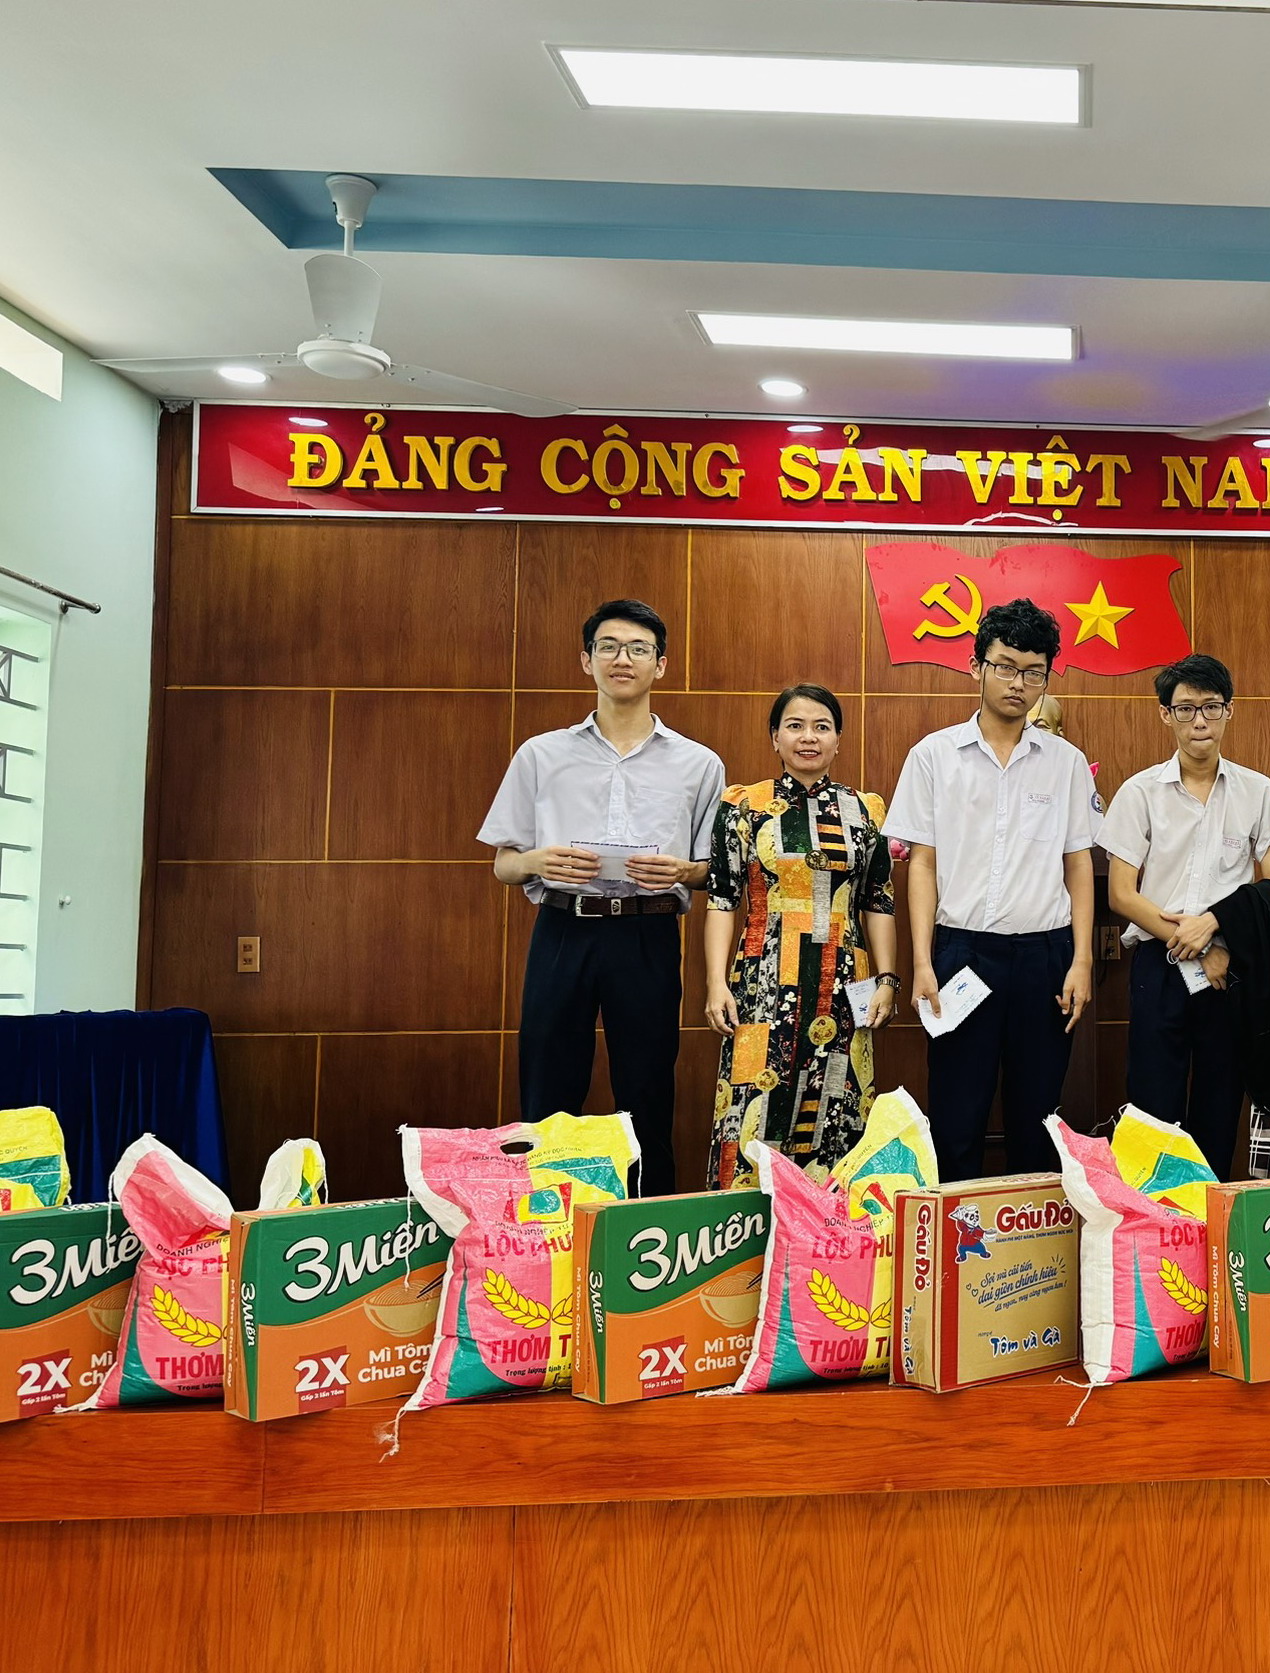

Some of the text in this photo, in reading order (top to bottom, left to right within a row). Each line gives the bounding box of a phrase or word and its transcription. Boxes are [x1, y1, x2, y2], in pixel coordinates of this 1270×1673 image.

[287, 412, 508, 493] ĐẢNG
[540, 424, 747, 511] CỘNG
[777, 424, 926, 504] SẢN
[956, 434, 1132, 521] VIỆT
[488, 1334, 552, 1364] THƠM
[704, 1337, 730, 1354] Mì
[809, 1336, 869, 1363] THƠM
[990, 1327, 1060, 1356] Tôm và Gà
[91, 1351, 113, 1369] Mì
[369, 1347, 391, 1365] Mì
[638, 1344, 688, 1381] 2X
[695, 1356, 738, 1373] Chua
[17, 1357, 72, 1396] 2X
[294, 1354, 350, 1393] 2X
[358, 1362, 406, 1383] Chua
